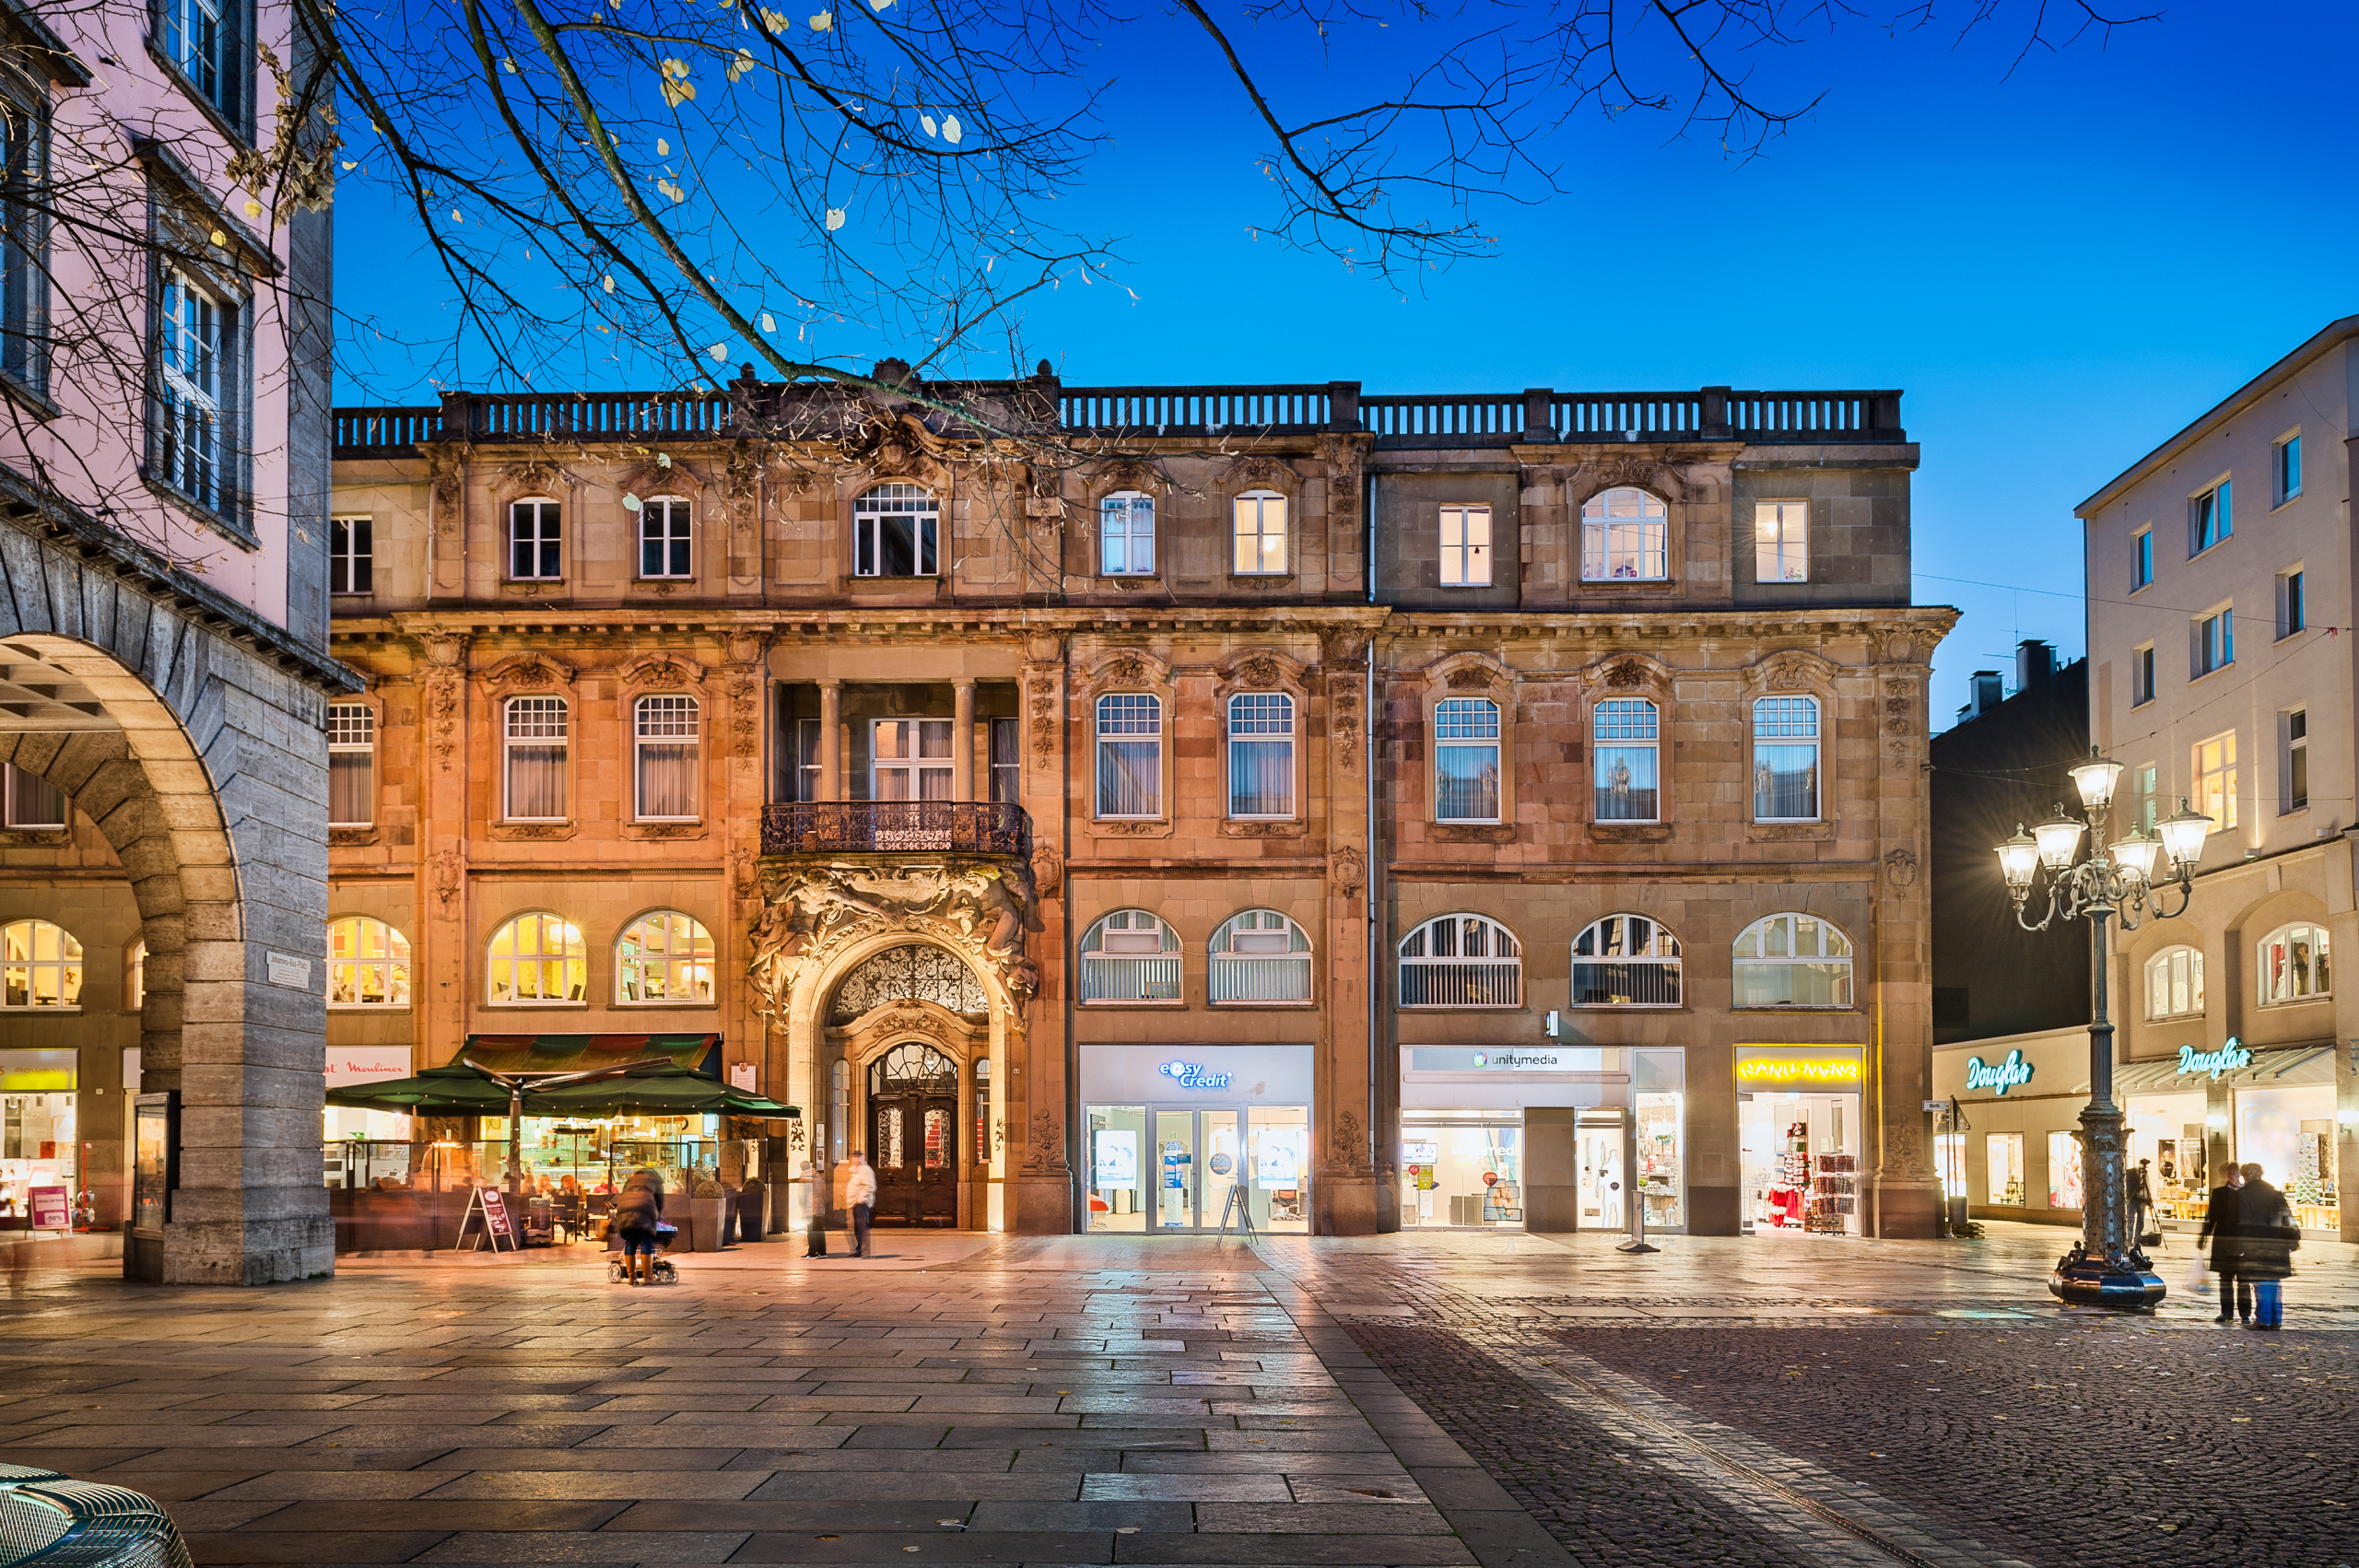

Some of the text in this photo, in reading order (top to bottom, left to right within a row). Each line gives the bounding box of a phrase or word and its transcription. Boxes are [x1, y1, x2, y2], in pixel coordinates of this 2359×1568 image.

[1492, 1055, 1557, 1067] unitymedia
[2177, 1036, 2249, 1080] Douglas
[346, 1061, 404, 1072] Moulinex
[1966, 1049, 2030, 1095] Douglas
[1180, 1073, 1226, 1087] Credit
[1165, 1141, 1181, 1151] 25%
